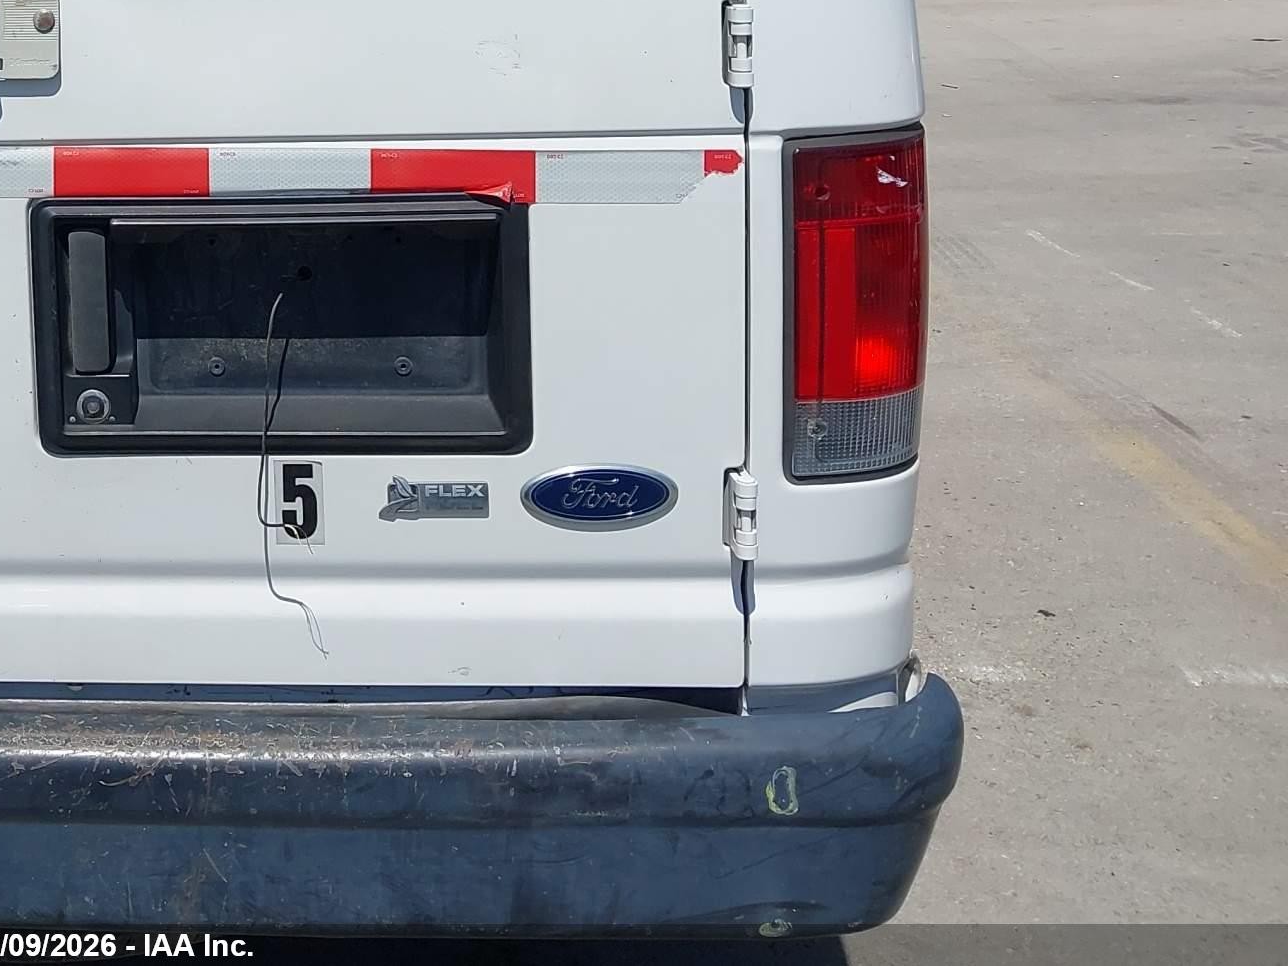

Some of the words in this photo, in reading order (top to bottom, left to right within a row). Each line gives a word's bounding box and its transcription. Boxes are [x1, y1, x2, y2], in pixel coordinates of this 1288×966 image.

[282, 463, 318, 540] 5
[424, 484, 485, 497] FLEX
[562, 477, 639, 509] Ford
